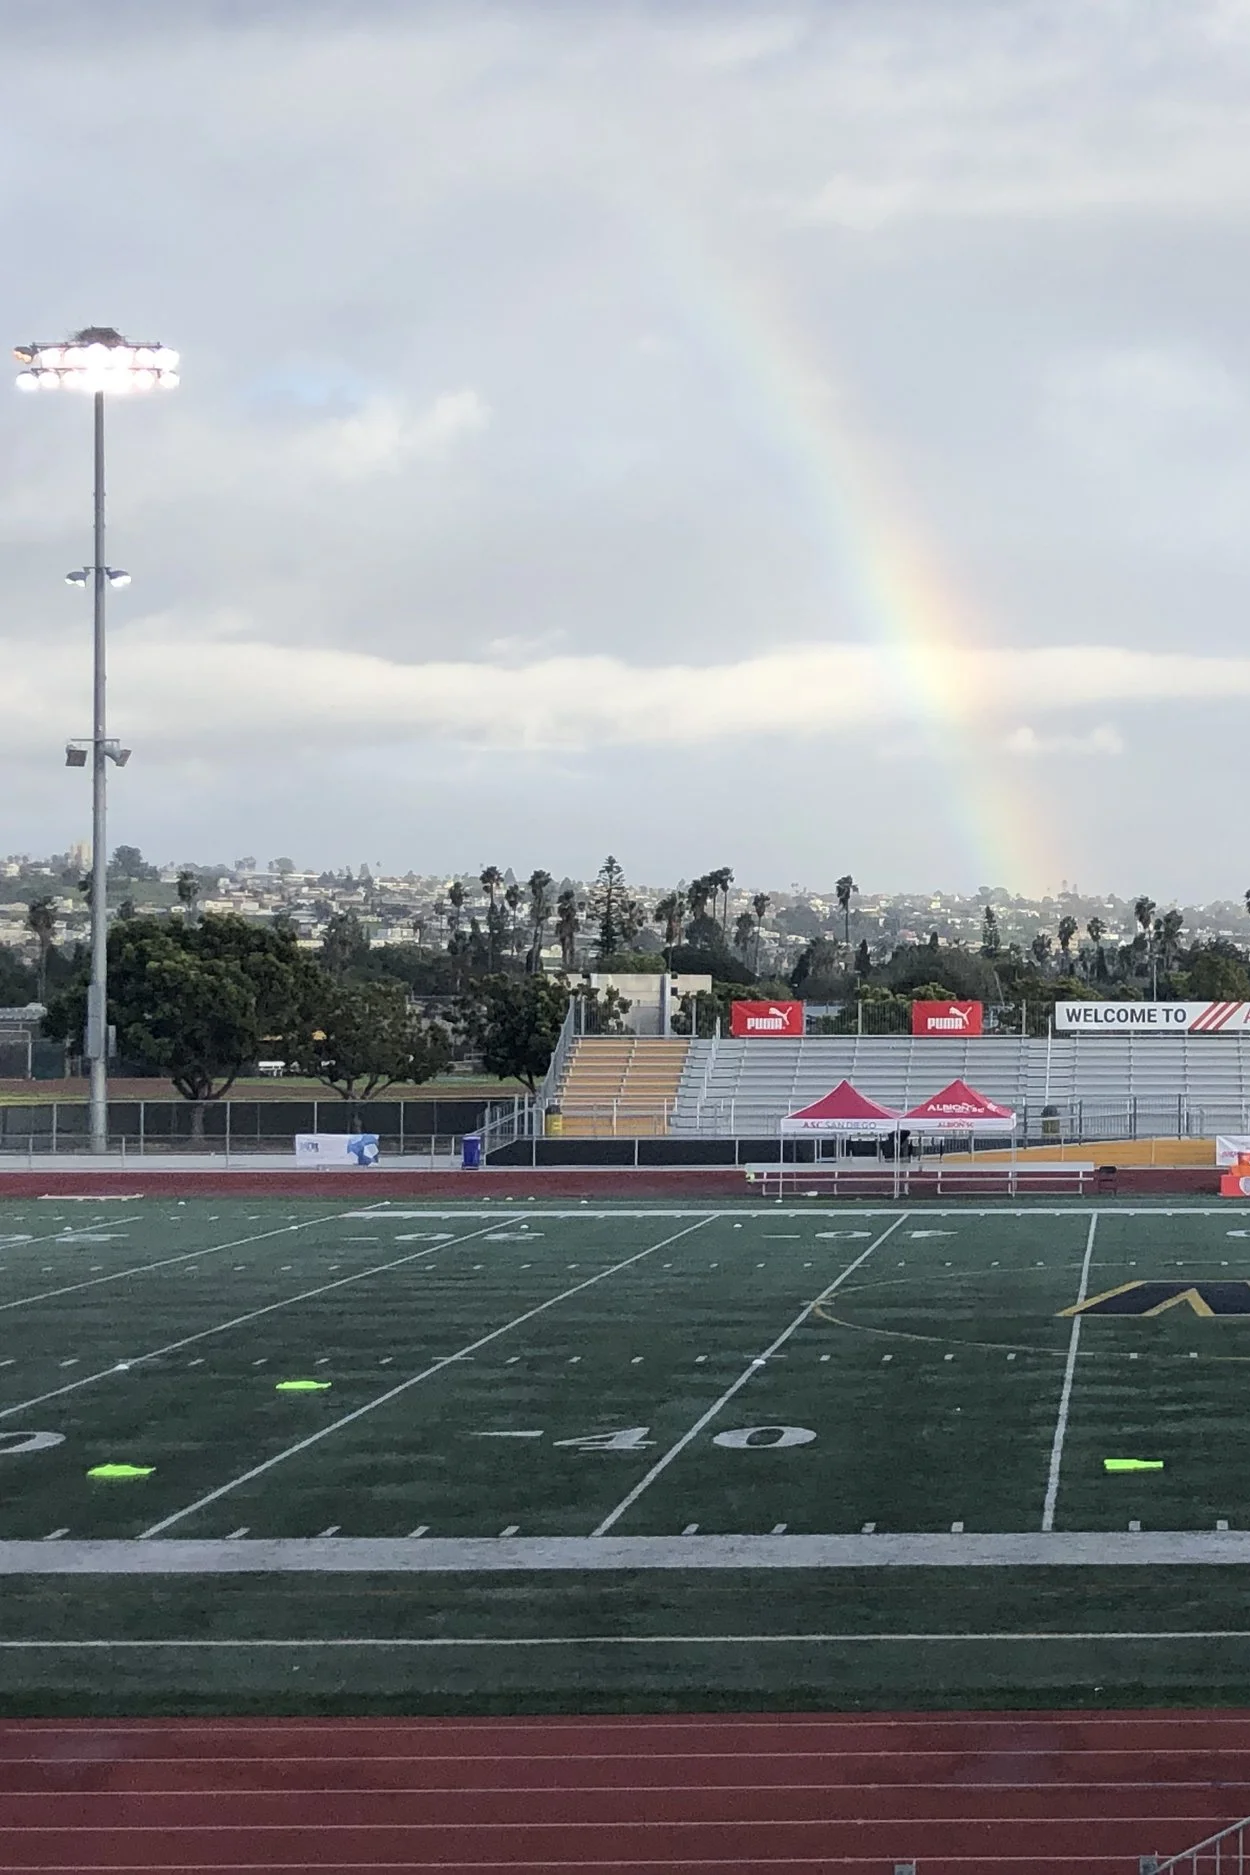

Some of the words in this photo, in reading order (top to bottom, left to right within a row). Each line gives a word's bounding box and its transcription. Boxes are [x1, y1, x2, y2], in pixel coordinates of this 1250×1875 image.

[1065, 1008, 1158, 1023] WELCOME
[1161, 1008, 1187, 1023] TO
[746, 1018, 784, 1030] PUMA
[927, 1018, 964, 1030] PUMA
